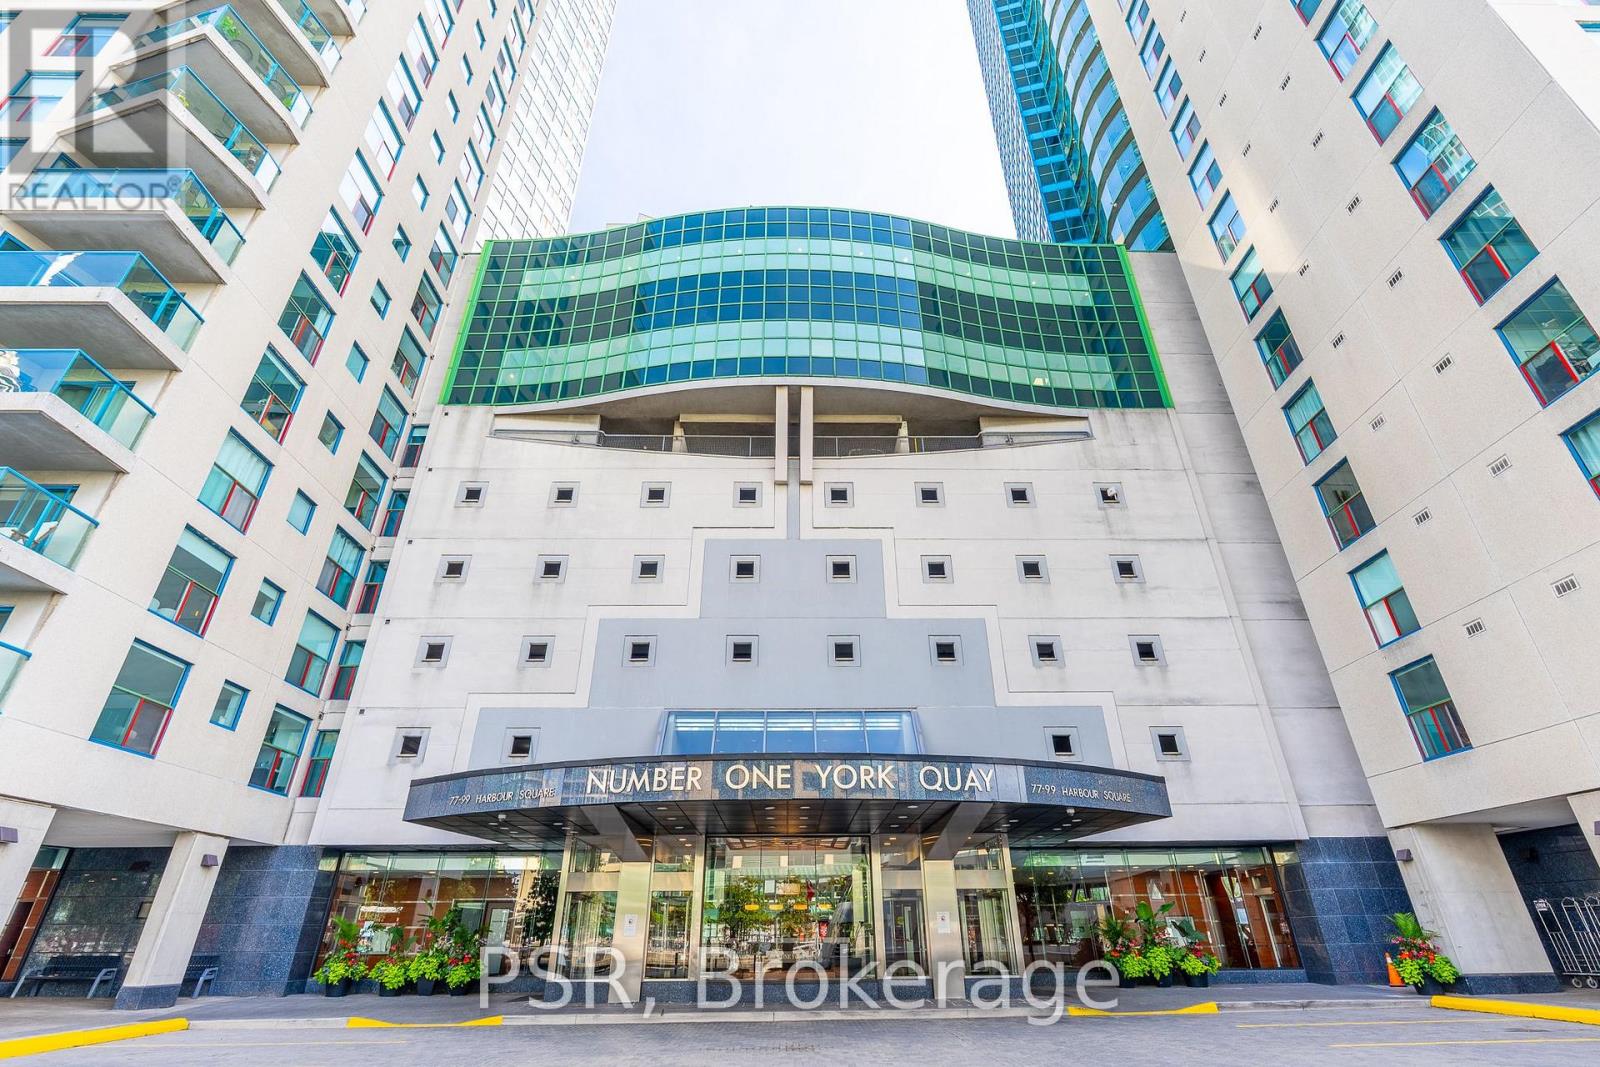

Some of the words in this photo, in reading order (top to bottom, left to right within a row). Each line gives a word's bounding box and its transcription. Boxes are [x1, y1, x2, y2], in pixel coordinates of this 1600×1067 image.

[586, 766, 702, 794] NUMBER
[725, 764, 791, 790] ONE
[814, 764, 895, 790] YORK
[919, 765, 994, 793] QUAY
[448, 794, 471, 806] 77-99
[475, 791, 514, 804] HARBOUR
[519, 787, 556, 800] SQUARE
[1062, 787, 1099, 799] HARBOUR
[1103, 790, 1132, 803] SQUARE
